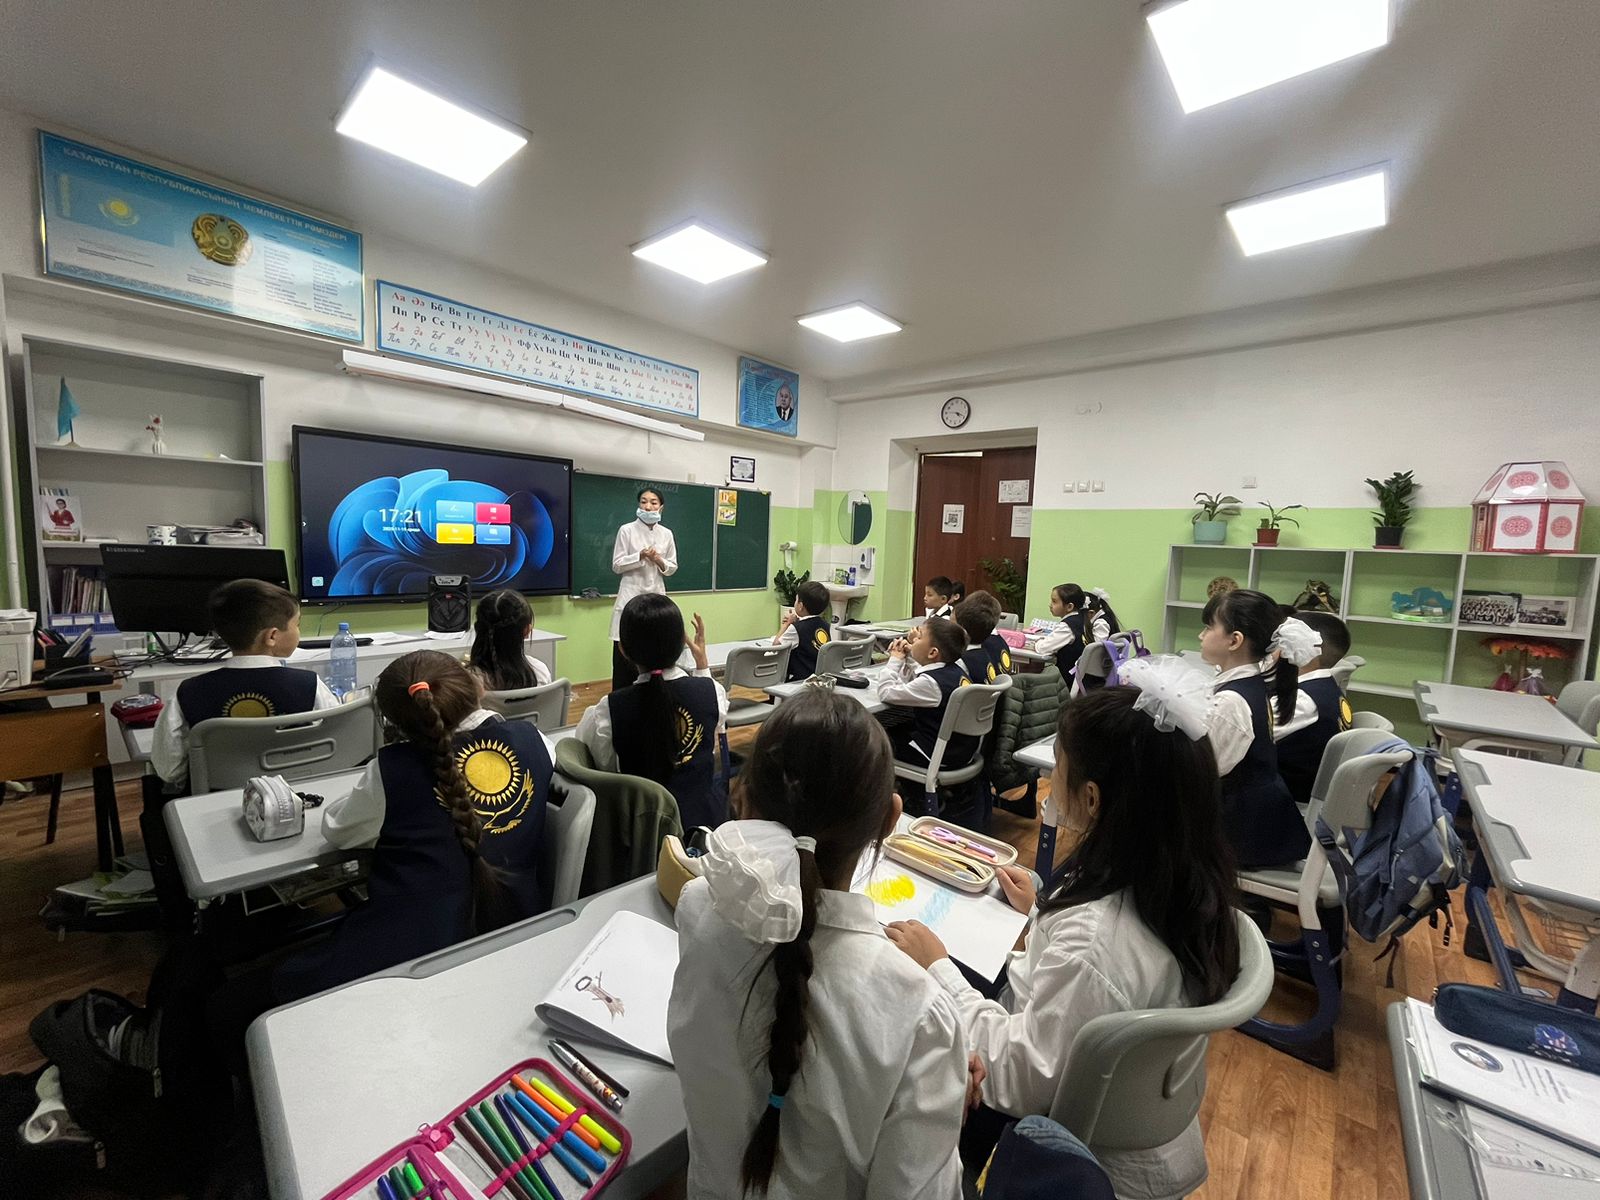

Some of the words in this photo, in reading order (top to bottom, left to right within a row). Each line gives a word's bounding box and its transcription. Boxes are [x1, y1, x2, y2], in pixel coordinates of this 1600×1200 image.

[392, 292, 406, 302] Аа
[430, 302, 443, 312] Бб
[392, 306, 408, 317] Пп
[414, 312, 426, 323] Рр
[432, 316, 445, 326] Сс
[379, 508, 421, 523] 17:21
